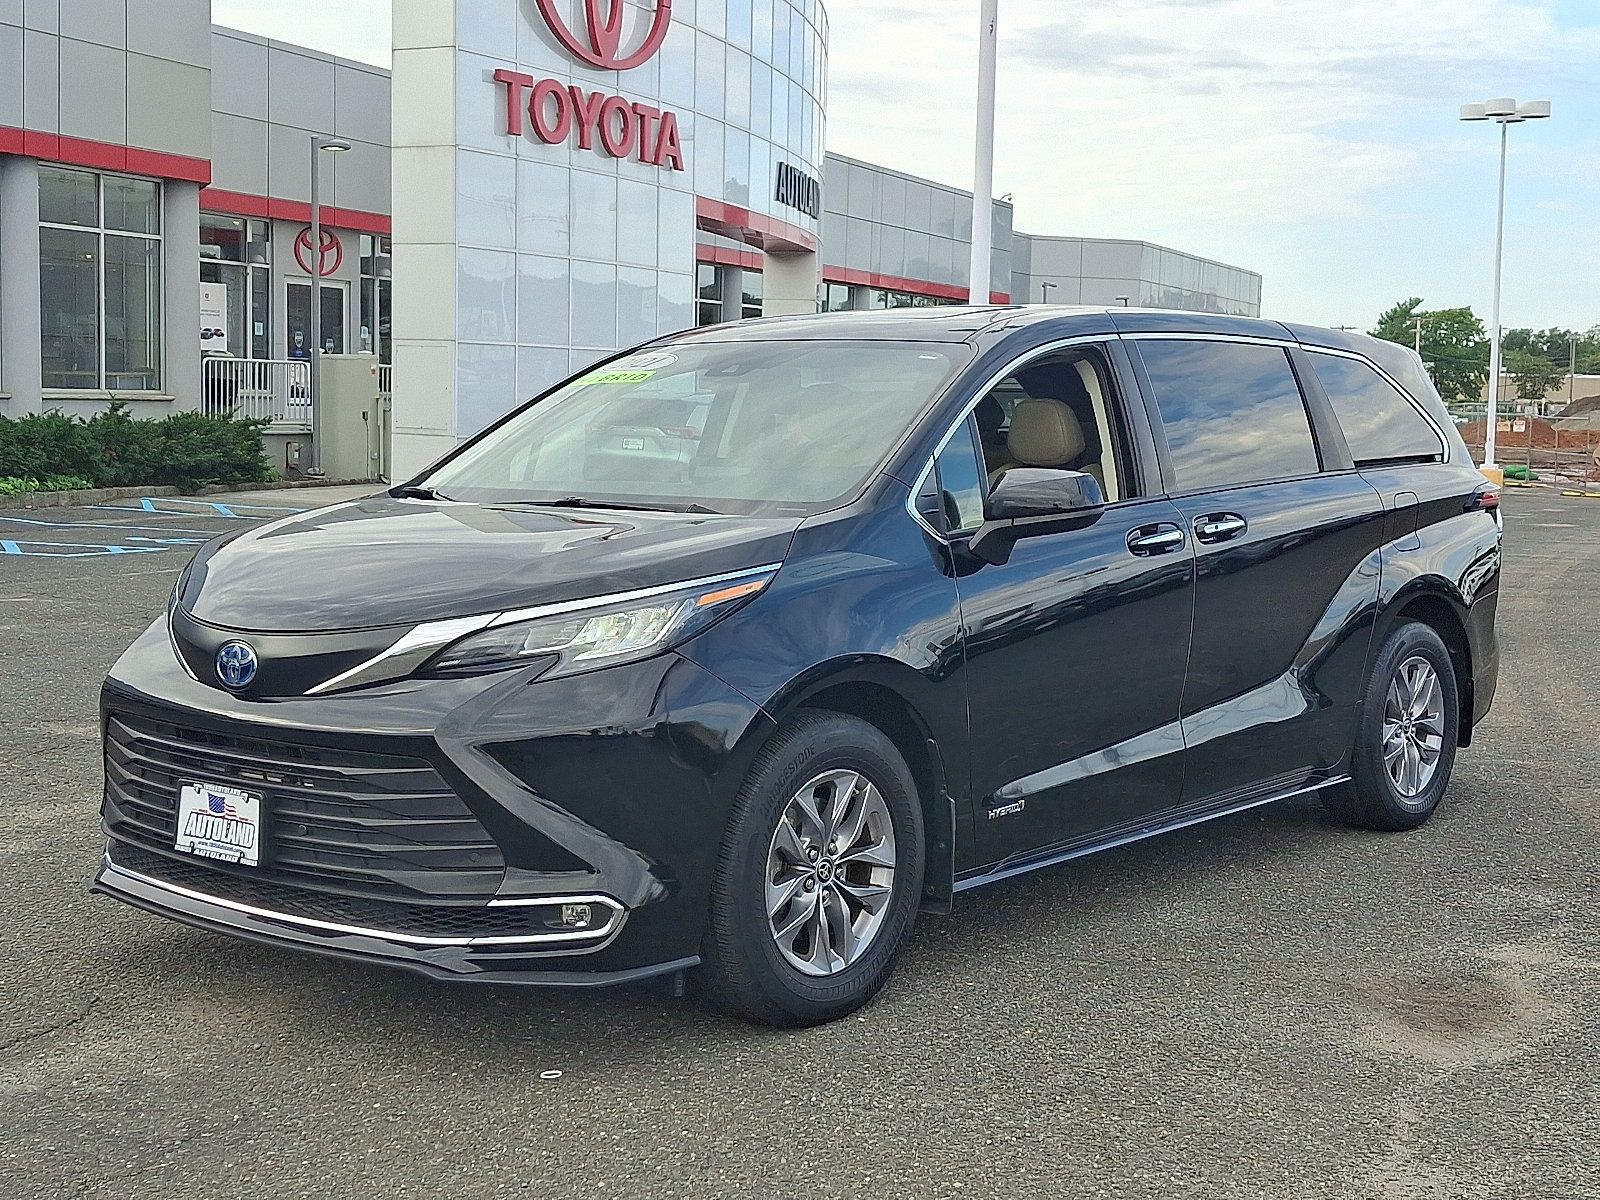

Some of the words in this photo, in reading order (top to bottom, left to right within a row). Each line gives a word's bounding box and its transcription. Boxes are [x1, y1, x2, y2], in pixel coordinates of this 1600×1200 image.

[494, 69, 684, 171] TOYOTA
[184, 811, 256, 849] AUTOLAND
[193, 848, 240, 863] AUTOLAND
